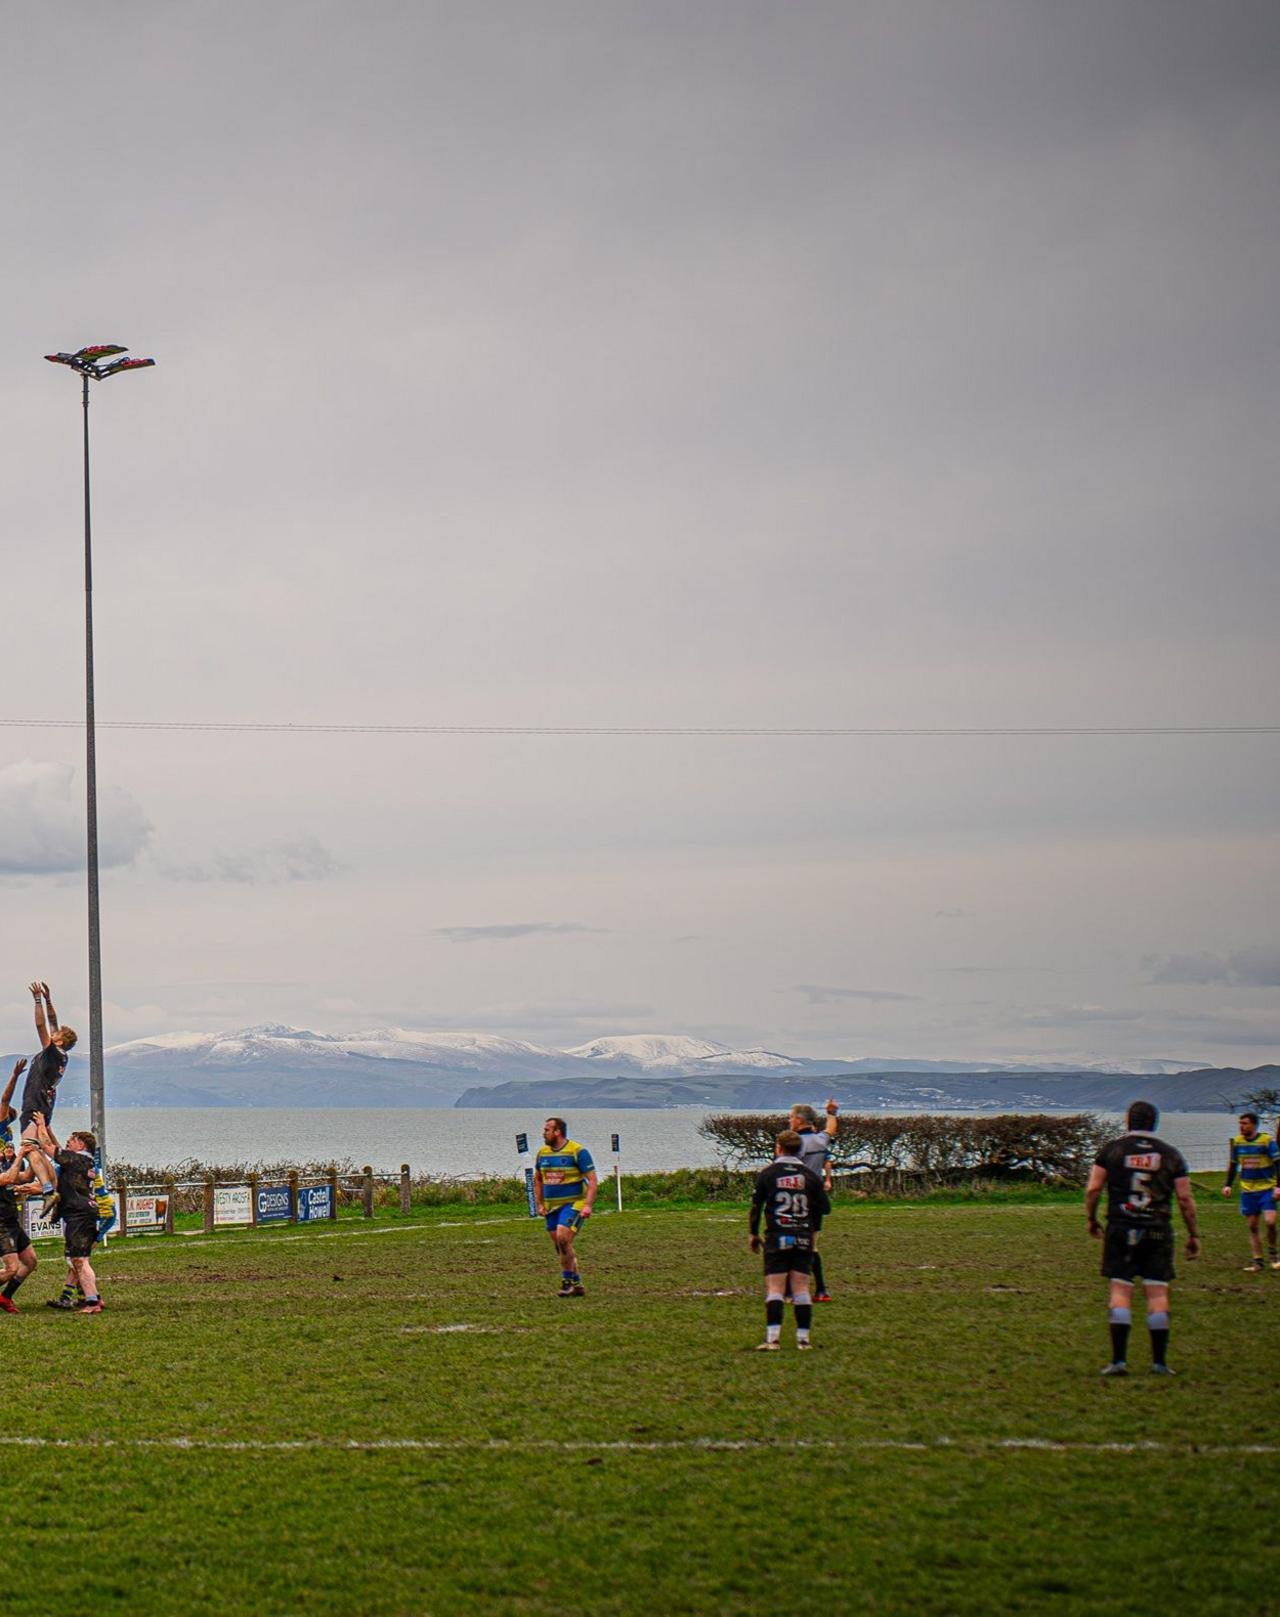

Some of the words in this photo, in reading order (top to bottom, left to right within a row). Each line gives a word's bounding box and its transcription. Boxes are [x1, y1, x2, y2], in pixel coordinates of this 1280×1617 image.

[308, 1186, 330, 1206] Castell
[1128, 1171, 1152, 1208] 5
[308, 1201, 331, 1219] Howell
[31, 1220, 62, 1232] EVANS
